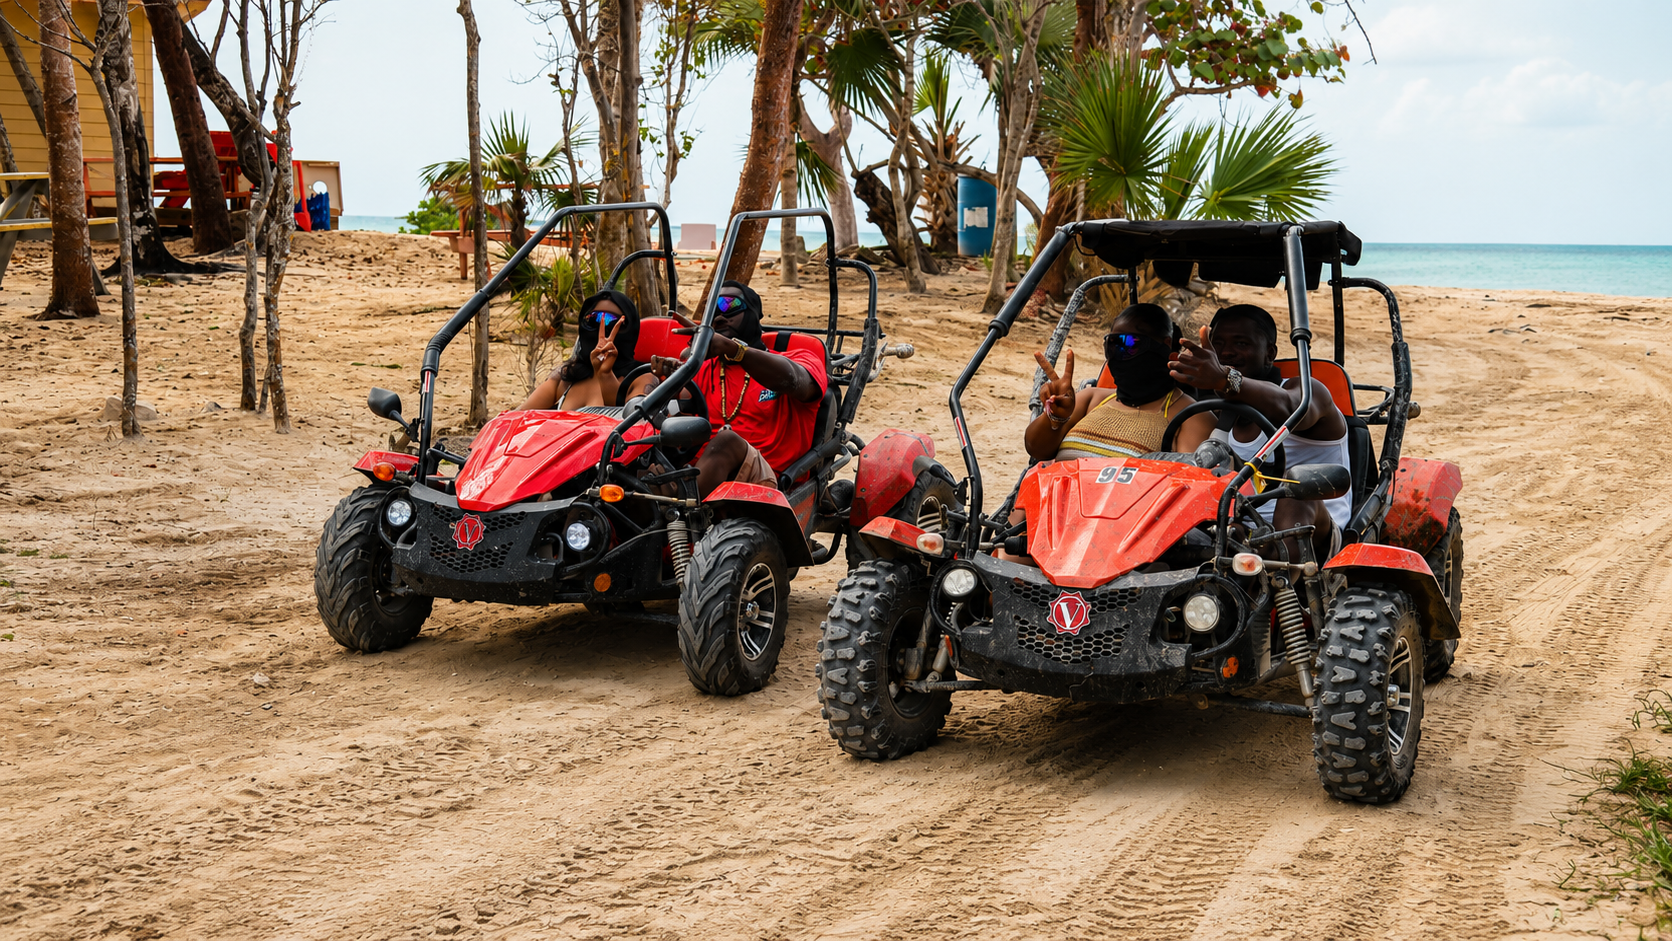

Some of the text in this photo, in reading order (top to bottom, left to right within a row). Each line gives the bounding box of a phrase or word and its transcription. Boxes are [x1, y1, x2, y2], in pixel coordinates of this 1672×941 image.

[1097, 466, 1137, 483] 95
[463, 522, 479, 545] V
[1058, 602, 1082, 629] V
